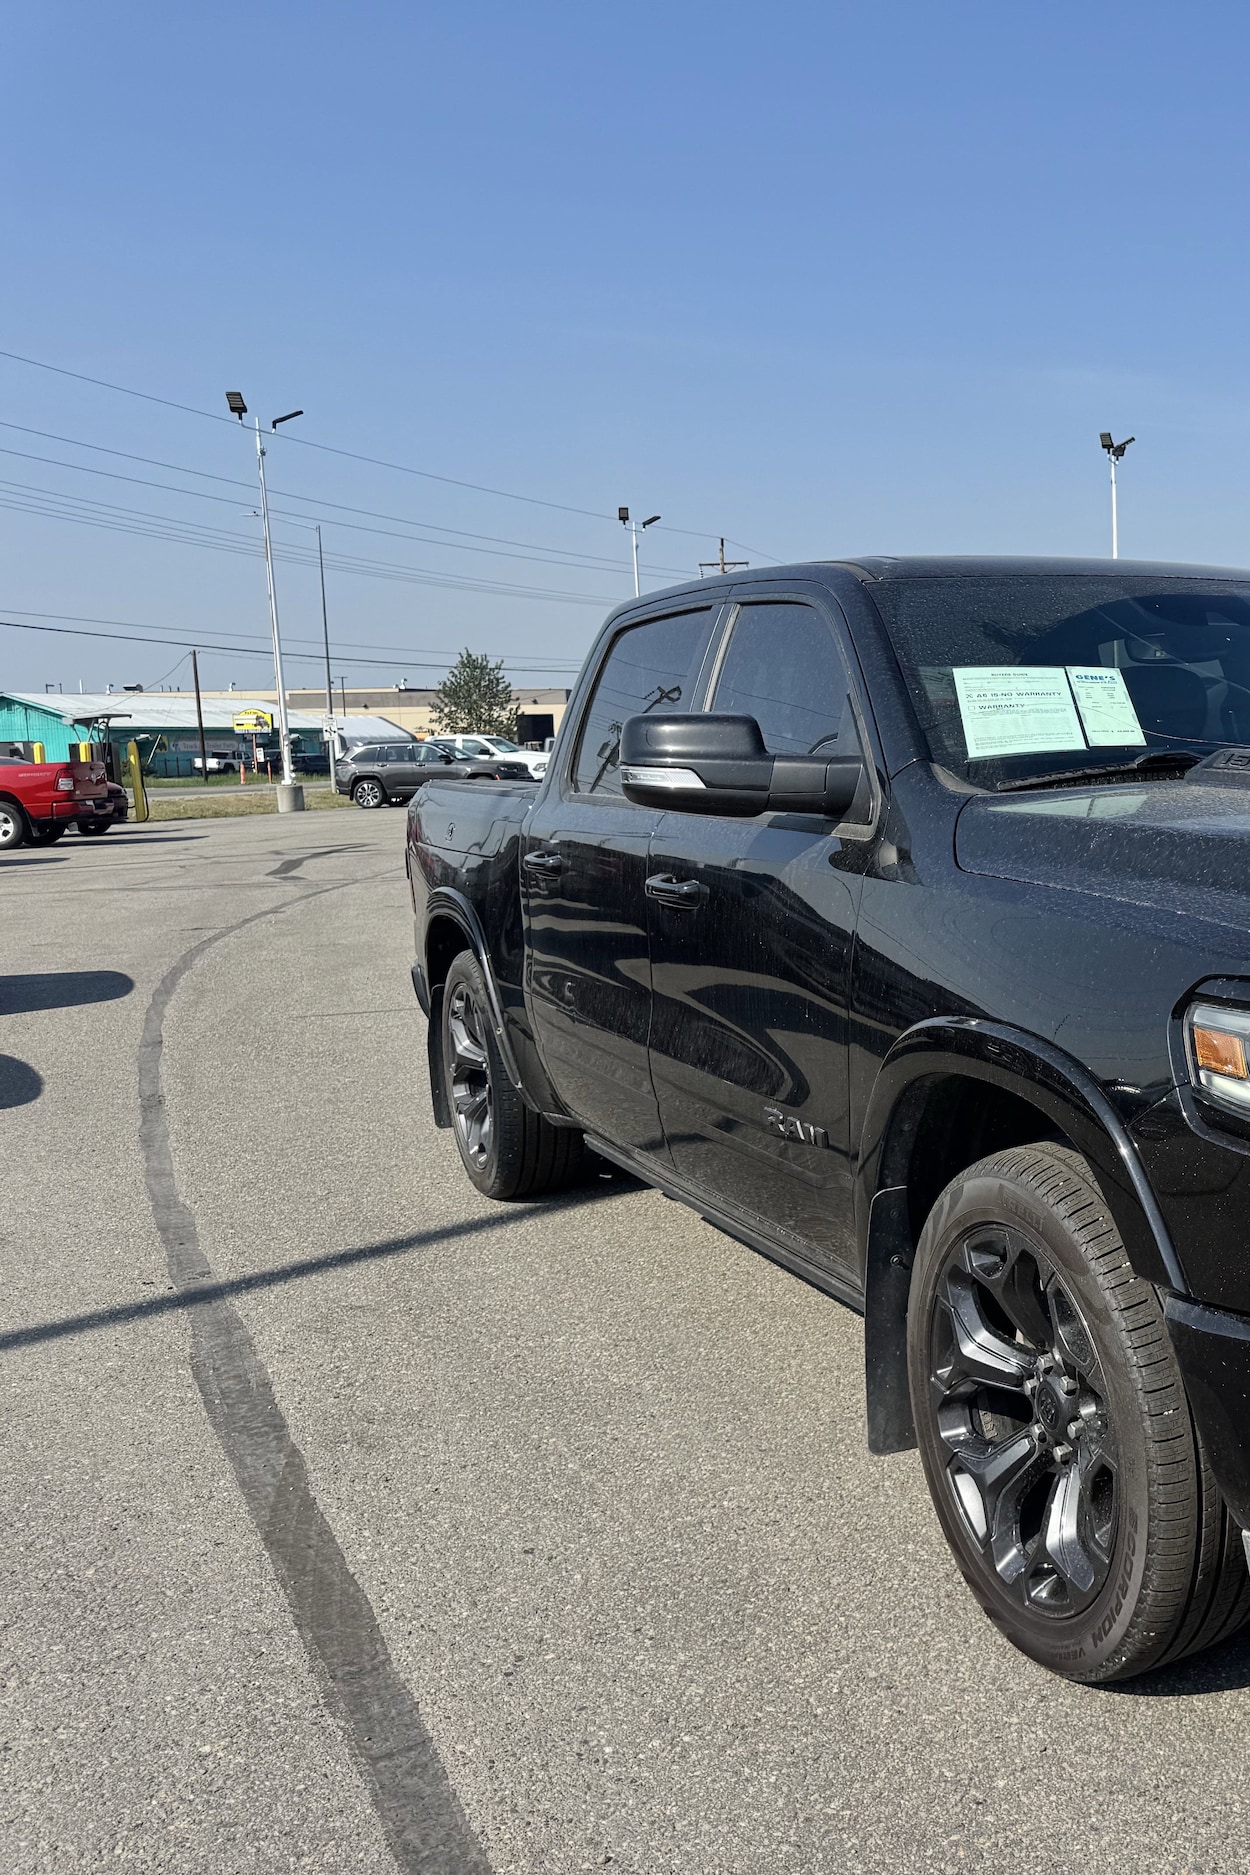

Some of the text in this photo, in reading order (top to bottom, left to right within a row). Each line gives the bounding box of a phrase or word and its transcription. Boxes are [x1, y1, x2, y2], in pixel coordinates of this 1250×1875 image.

[1075, 674, 1116, 682] GENE'S
[763, 1107, 830, 1148] RAM
[1091, 1507, 1138, 1648] SCORPION
